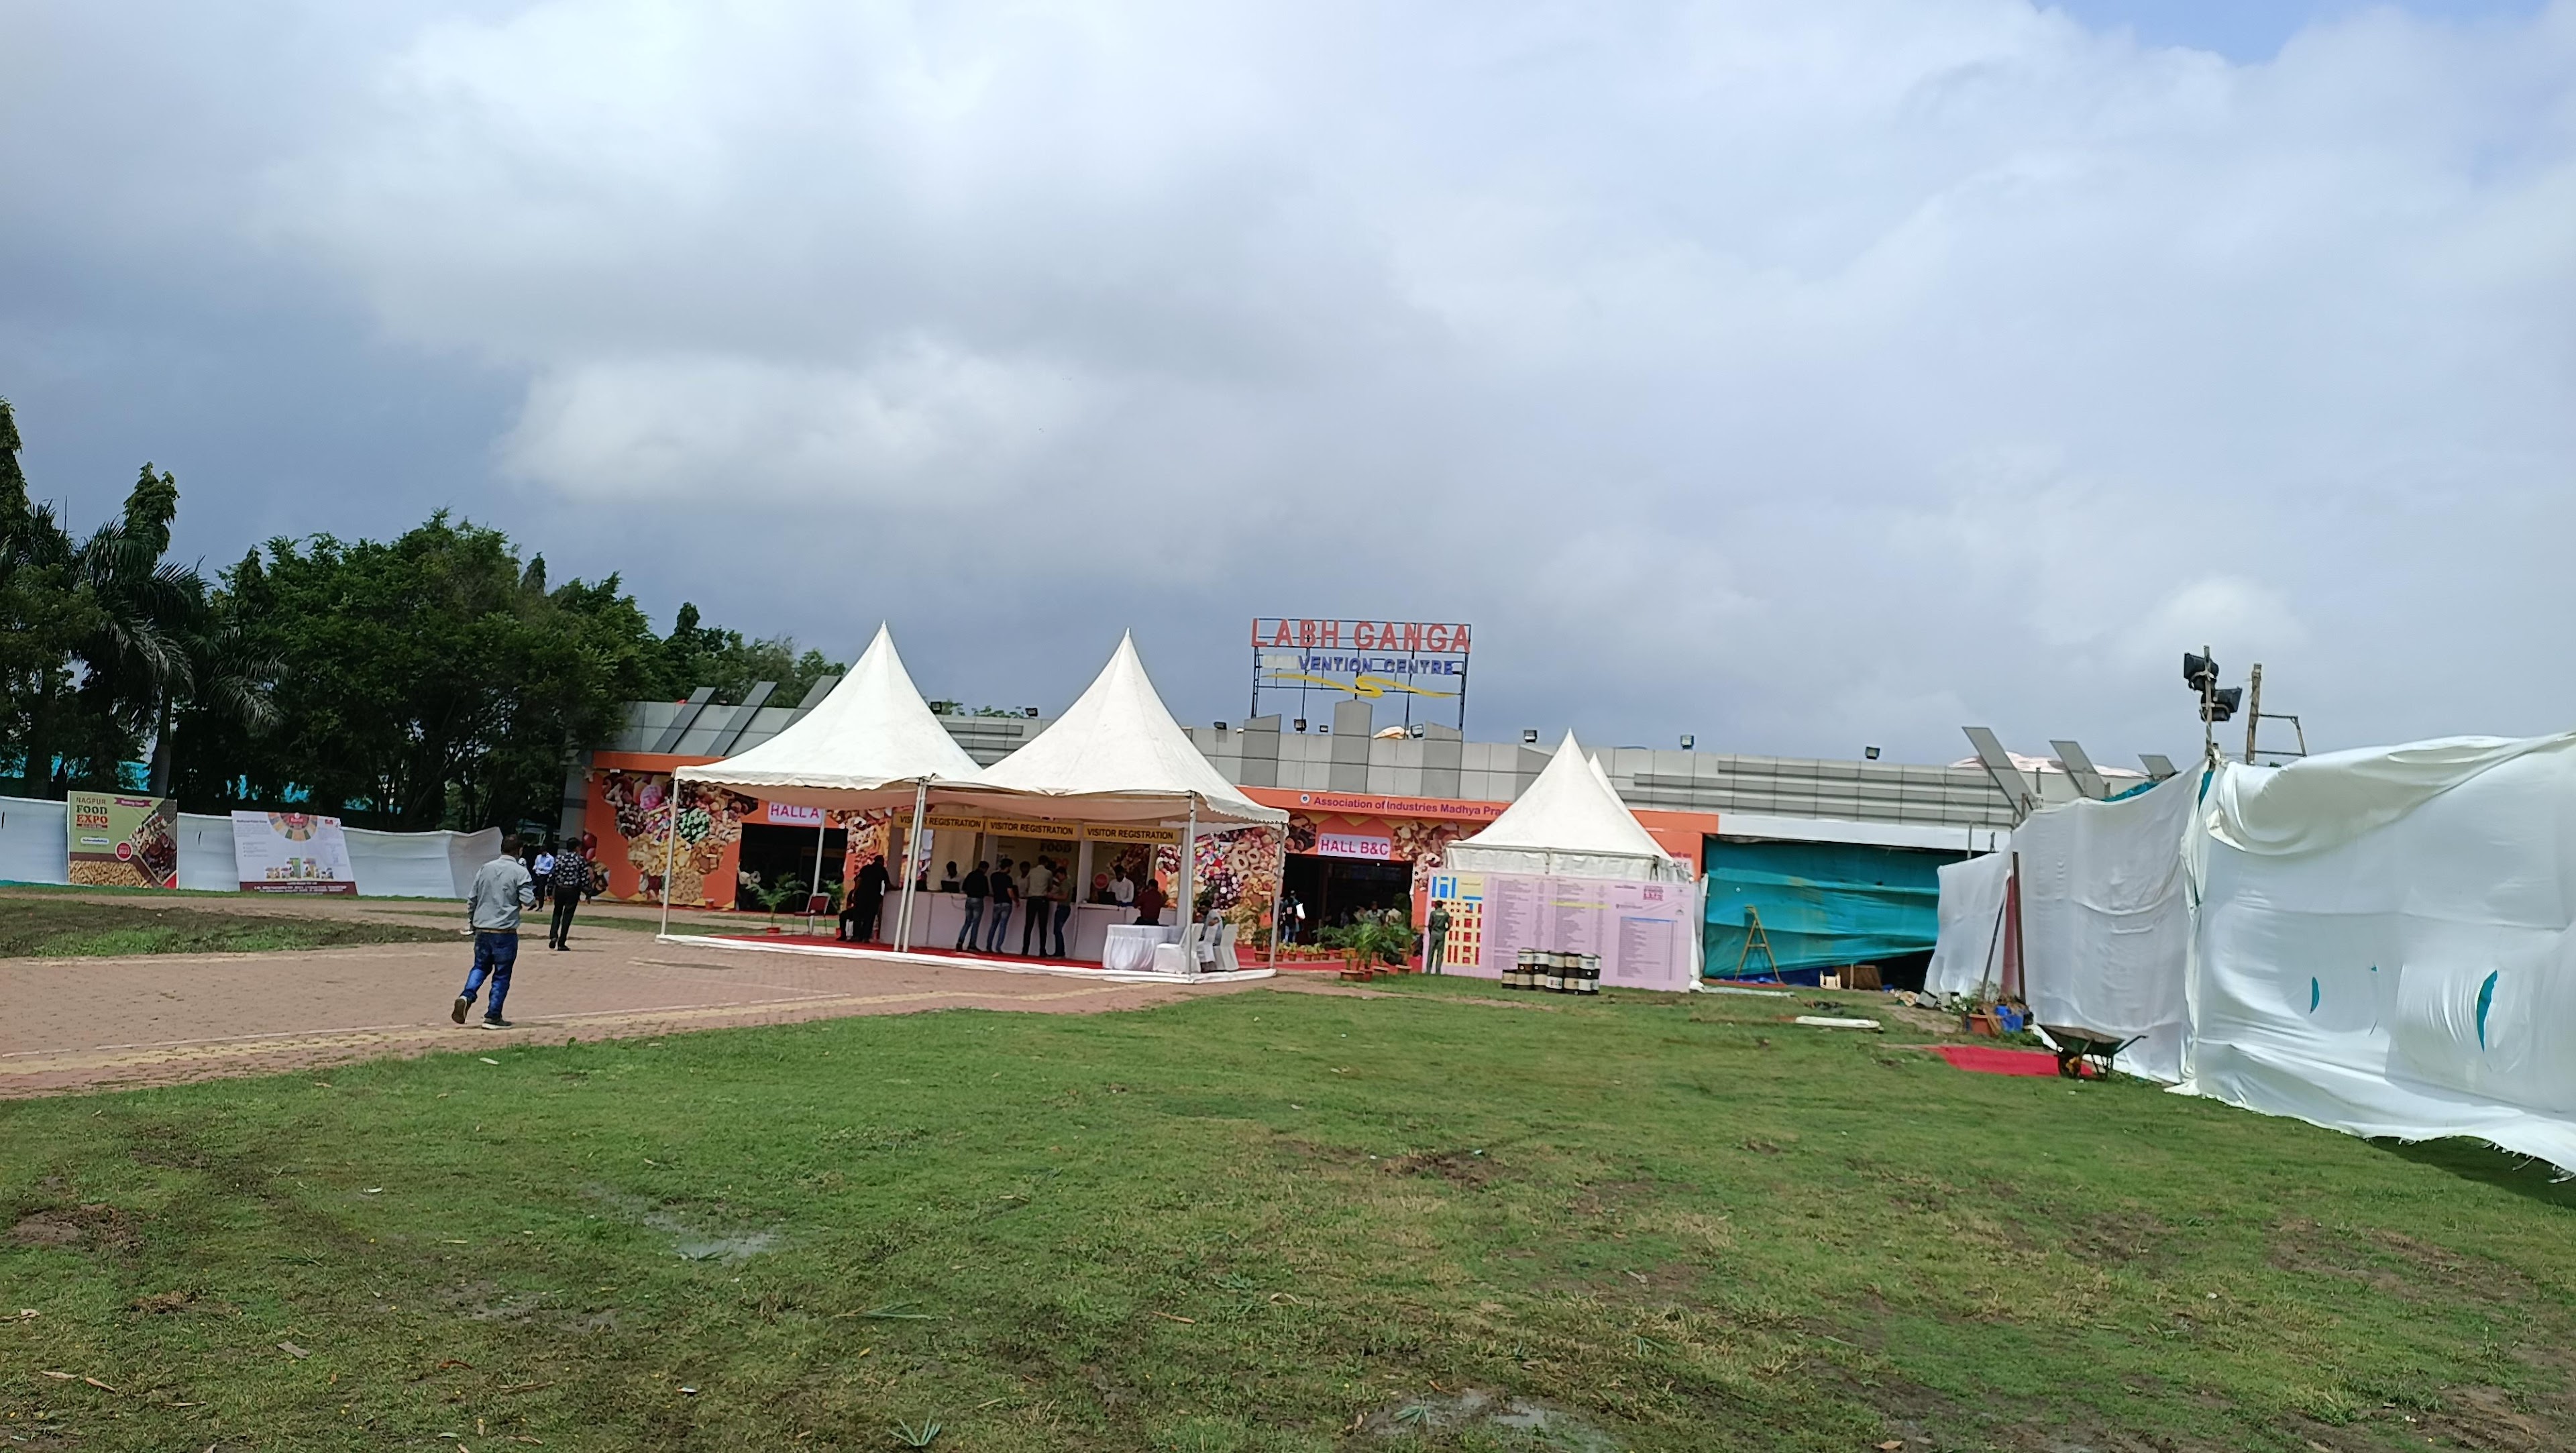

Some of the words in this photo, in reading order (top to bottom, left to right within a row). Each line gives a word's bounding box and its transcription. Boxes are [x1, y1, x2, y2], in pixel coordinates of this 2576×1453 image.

[1251, 618, 1339, 649] LABH
[1354, 621, 1470, 653] GANGA
[1298, 655, 1373, 672] VENTION
[1384, 659, 1453, 675] CENTRE
[76, 805, 107, 814] FOOD
[771, 804, 806, 818] HALL
[810, 808, 819, 818] A
[1313, 796, 1374, 808] Association
[1375, 800, 1385, 809] of
[1387, 800, 1438, 813] Industries
[1440, 804, 1481, 816] Madhya
[1483, 806, 1502, 816] Pra
[76, 814, 108, 824] EXPO
[900, 816, 928, 825] VISR
[929, 817, 981, 828] REGISTRATION
[990, 822, 1018, 831] VISITOR
[1020, 824, 1073, 835] REGISTRATION
[1087, 828, 1116, 837] VISITOR
[1118, 829, 1173, 839] REGISTRATION
[1320, 839, 1356, 854] HALL
[1360, 841, 1389, 855] B&C
